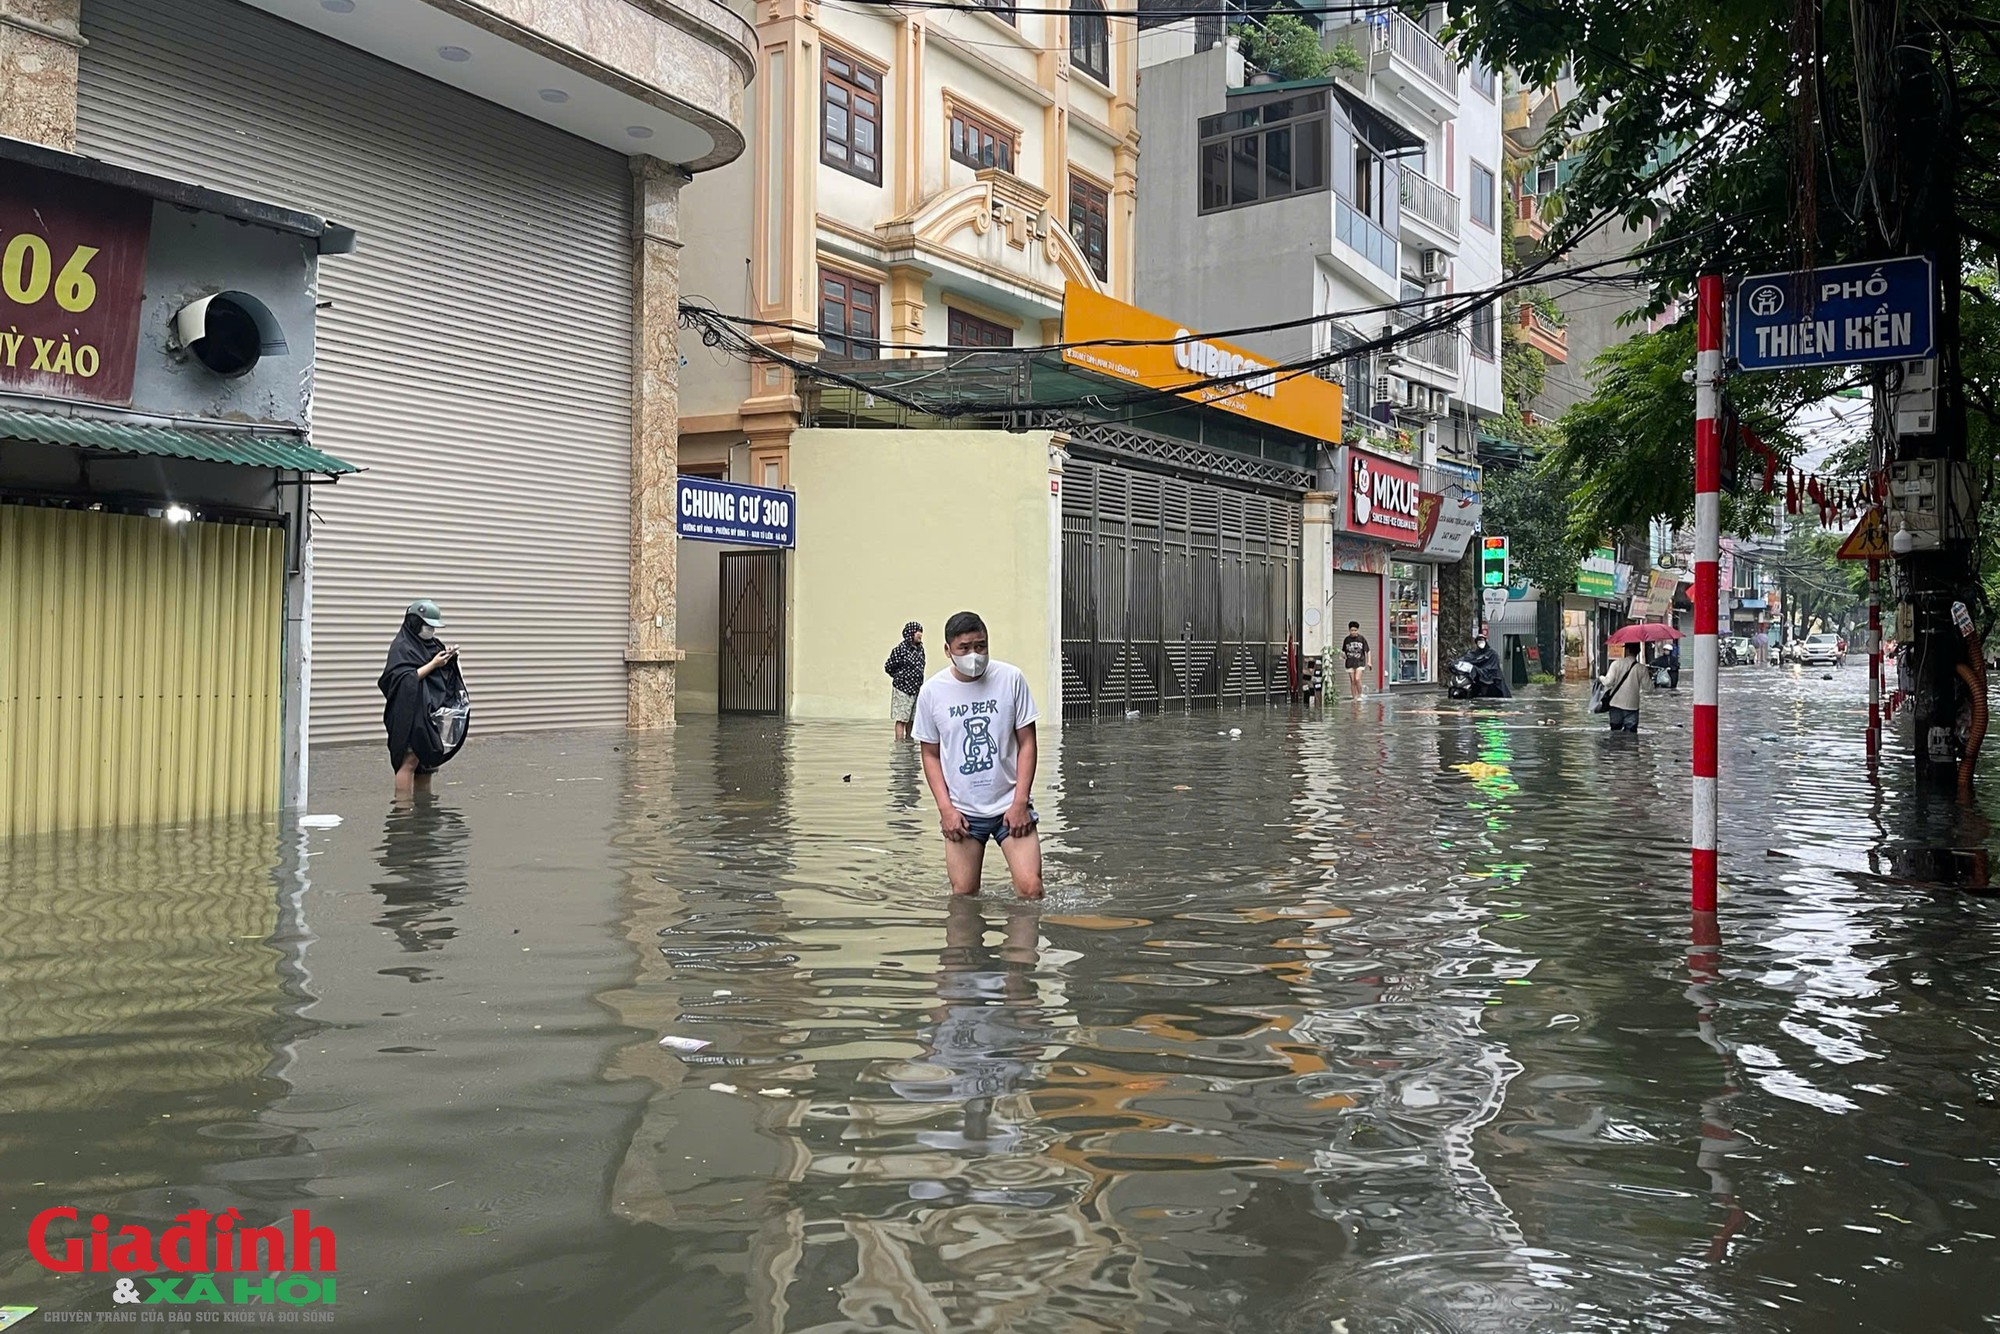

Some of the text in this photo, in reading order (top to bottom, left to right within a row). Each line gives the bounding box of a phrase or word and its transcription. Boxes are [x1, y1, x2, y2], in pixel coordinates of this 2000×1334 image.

[1821, 267, 1888, 301] PHỐ
[0, 325, 100, 378] Ỳ XÀO
[1755, 303, 1911, 358] THIÊN HIỀN
[681, 487, 788, 528] CHUNG CƯ 300
[1373, 471, 1419, 517] MIXUE
[948, 699, 998, 718] BAD BEAR
